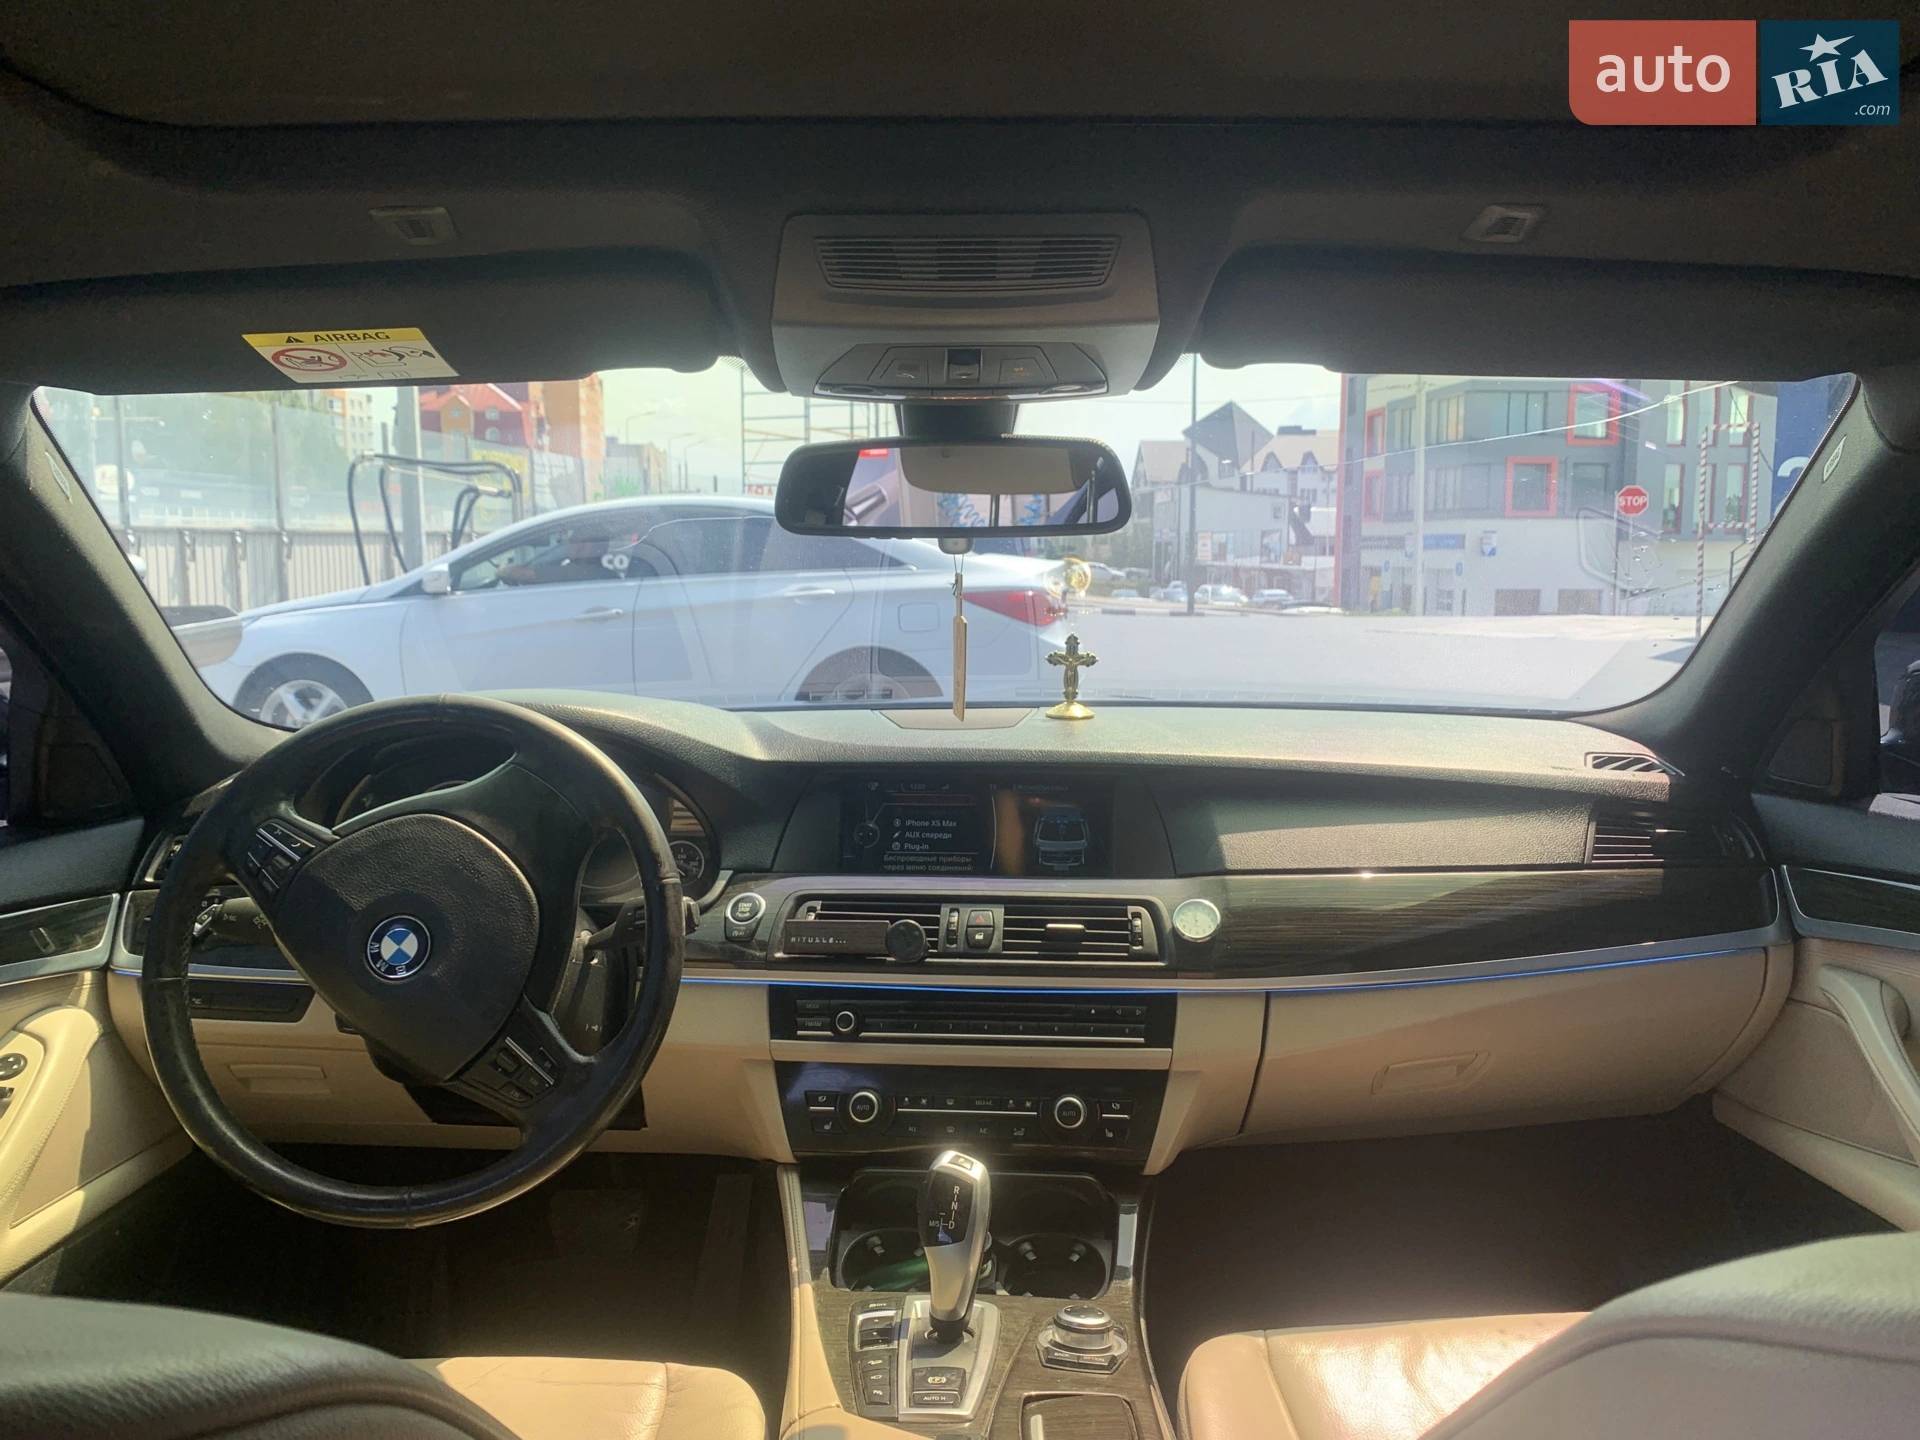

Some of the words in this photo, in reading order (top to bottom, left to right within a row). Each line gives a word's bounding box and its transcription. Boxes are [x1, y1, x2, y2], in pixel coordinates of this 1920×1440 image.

[313, 331, 391, 343] AIRBAG
[1619, 496, 1647, 507] STOP
[905, 819, 929, 827] iPhone
[904, 843, 929, 851] Plug-in
[884, 855, 938, 863] Беспроводные
[938, 855, 972, 863] приборы
[953, 1186, 960, 1195] R
[951, 1201, 958, 1210] N
[948, 1220, 955, 1230] D
